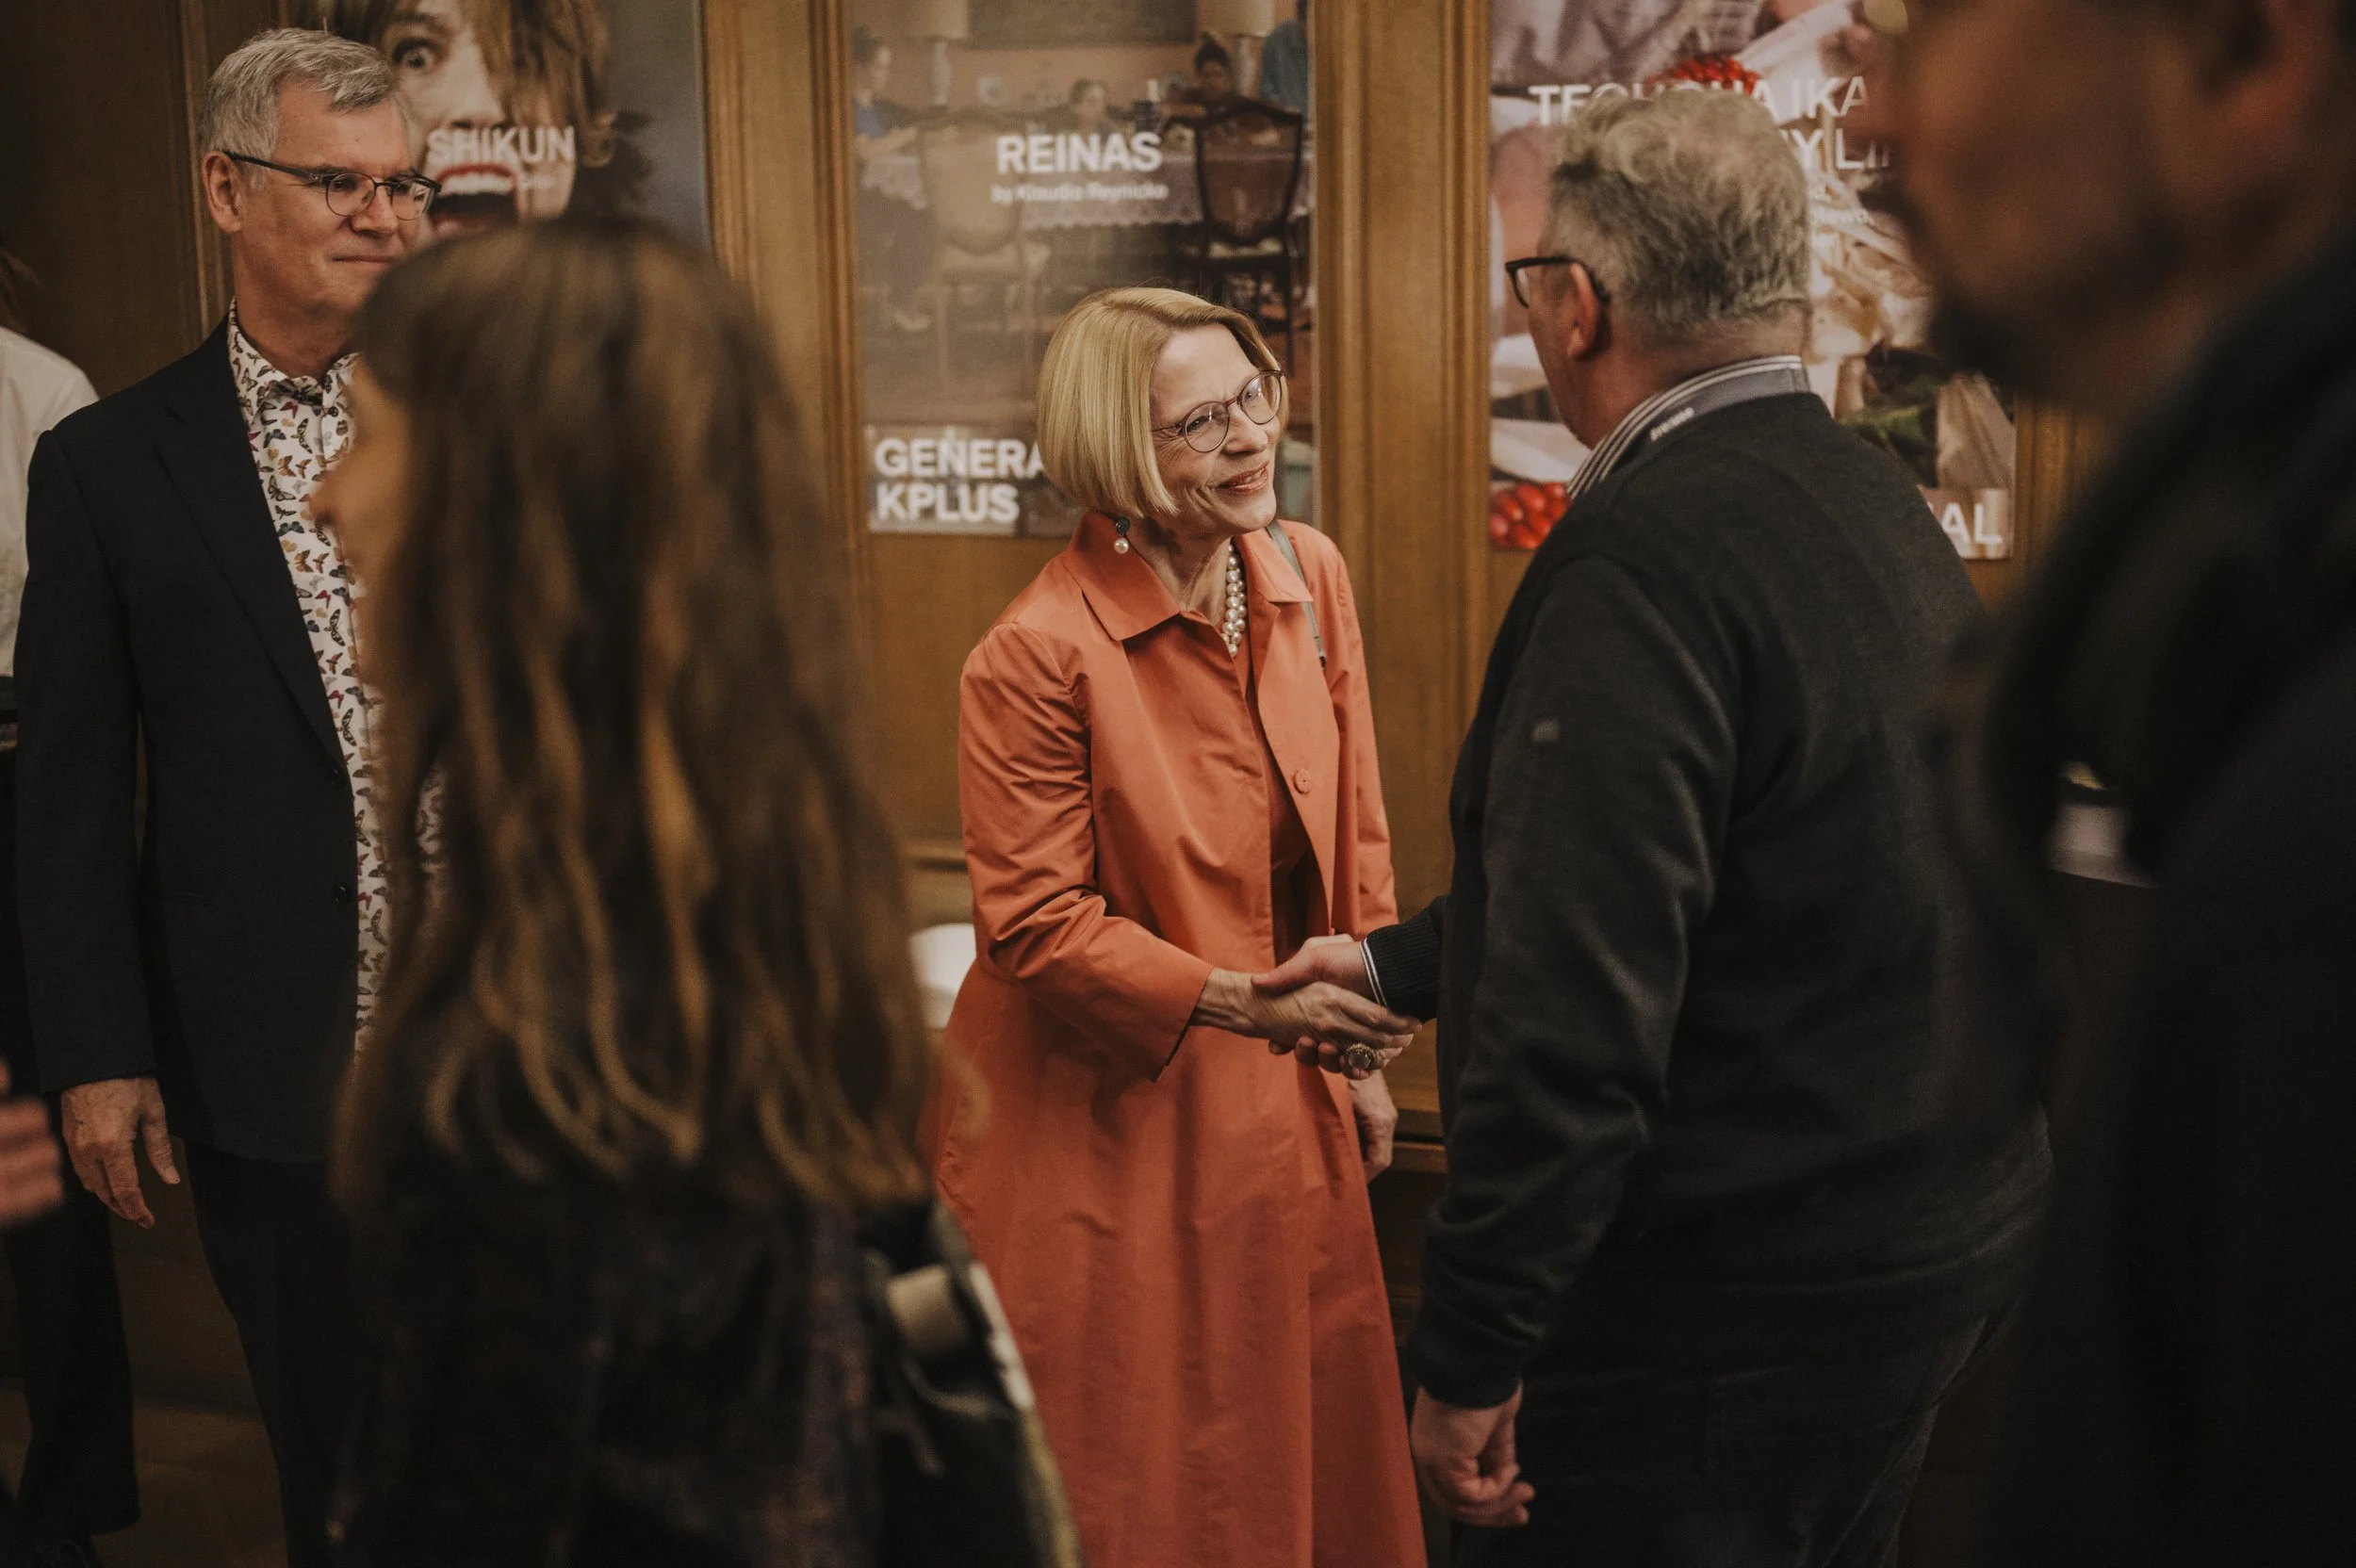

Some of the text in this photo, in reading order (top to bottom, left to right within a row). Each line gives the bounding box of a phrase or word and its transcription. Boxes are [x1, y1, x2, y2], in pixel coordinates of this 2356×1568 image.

[1798, 75, 1870, 120] IKA
[427, 126, 575, 163] SHIKUN
[996, 132, 1163, 173] REINAS
[1835, 127, 1890, 170] LI
[875, 437, 1045, 479] GENERA
[876, 482, 1020, 522] KPLUS
[1939, 501, 2004, 545] AL
